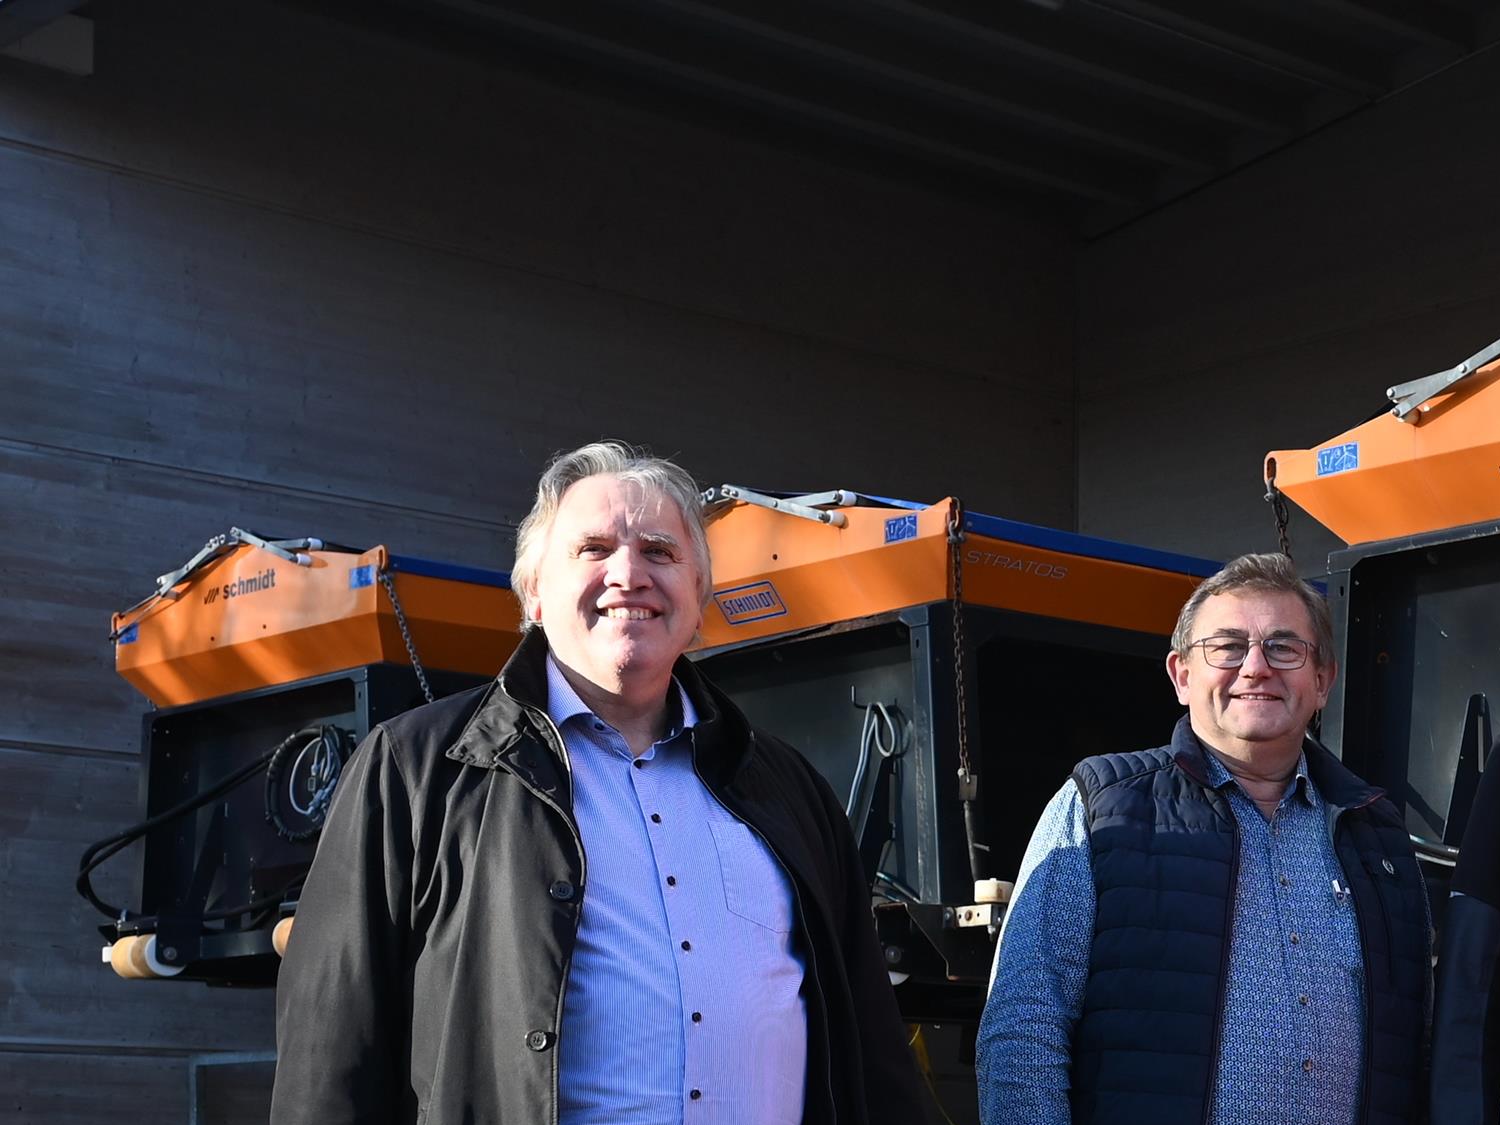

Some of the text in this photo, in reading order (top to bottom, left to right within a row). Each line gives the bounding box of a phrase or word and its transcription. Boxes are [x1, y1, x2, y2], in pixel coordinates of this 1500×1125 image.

[965, 550, 1069, 579] STRATOS
[222, 567, 276, 601] schmidt
[722, 591, 776, 616] SCHMIDT
